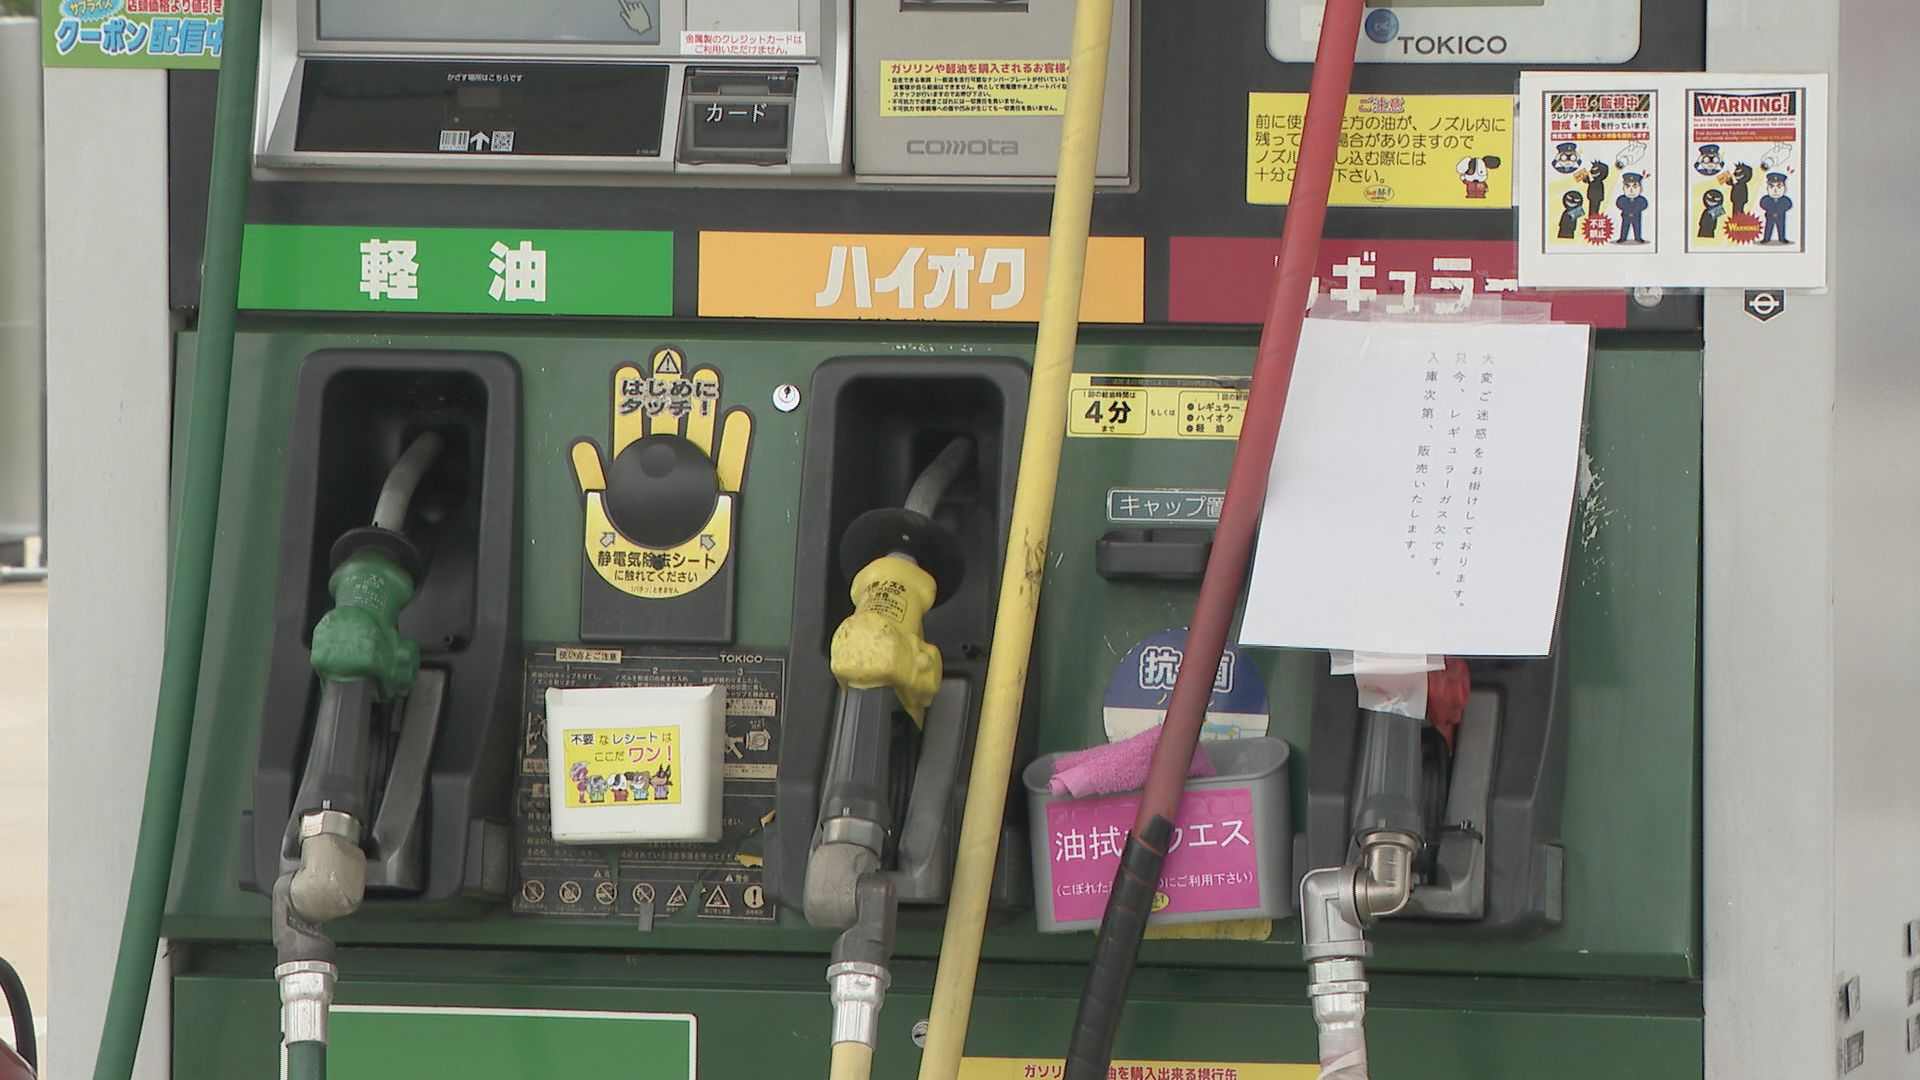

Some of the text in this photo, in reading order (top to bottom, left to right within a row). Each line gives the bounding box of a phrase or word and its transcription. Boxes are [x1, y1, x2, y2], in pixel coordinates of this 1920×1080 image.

[1398, 36, 1507, 55] TOKICO
[705, 103, 767, 123] カード
[1700, 95, 1789, 114] WARNING!
[1255, 114, 1507, 134] 前に使方の油が、ノズル内に
[1255, 132, 1475, 150] 残って場合がありますので
[1256, 150, 1427, 168] ノズルし込む際には
[1255, 167, 1386, 185] 十分ご下さい。
[815, 245, 1026, 310] ハイオク
[622, 379, 718, 398] はじめに
[621, 398, 709, 417] タッチ！
[1084, 400, 1131, 424] 4分
[1150, 409, 1176, 417] もしくは
[1196, 413, 1233, 423] ハイオク
[1101, 425, 1115, 433] まで
[1404, 352, 1439, 560] 入庫次第、販売いたします。
[1429, 352, 1467, 577] 只今、レギュラーガス欠です。
[1453, 352, 1495, 607] 大変ご迷惑をお掛けしております。
[614, 570, 698, 583] に触れてください
[720, 654, 763, 664] TOKICO
[1055, 819, 1251, 862] 油拭エス
